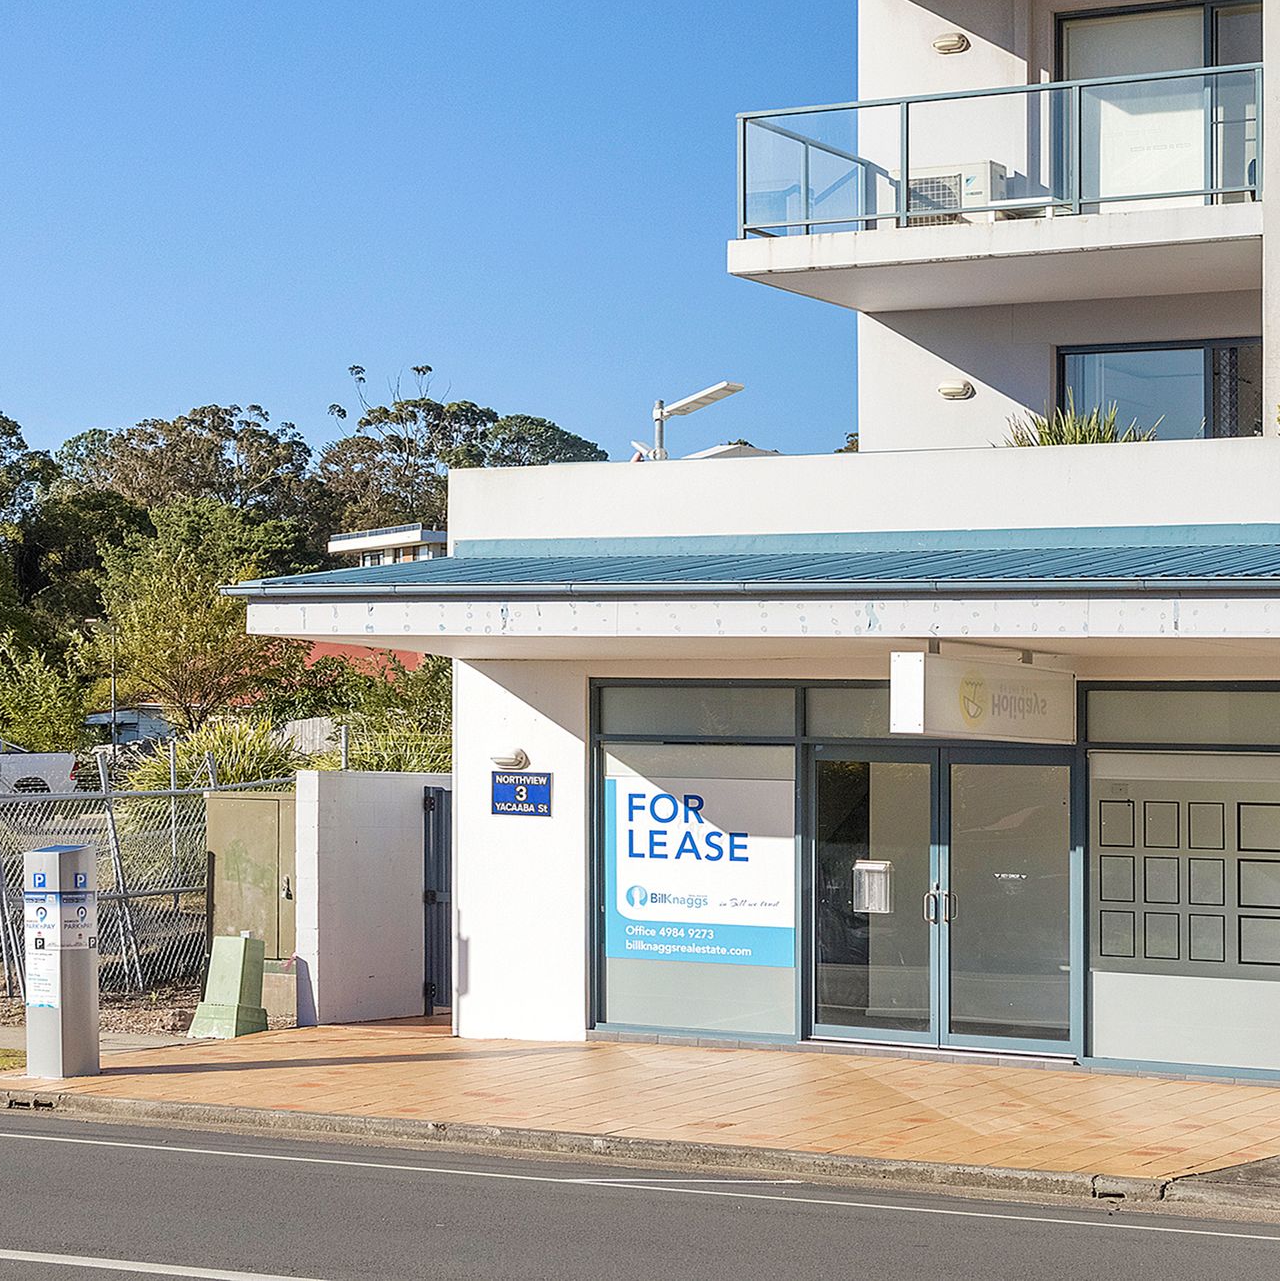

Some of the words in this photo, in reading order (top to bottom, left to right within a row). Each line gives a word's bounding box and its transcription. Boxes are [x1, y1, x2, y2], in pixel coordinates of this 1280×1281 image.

[496, 775, 547, 785] NORTHVIEW
[515, 785, 527, 802] 3
[495, 802, 535, 813] YACAABA
[537, 804, 548, 813] St
[628, 793, 705, 824] FOR
[628, 829, 749, 862] LEASE
[625, 925, 656, 936] Office
[659, 926, 685, 938] 4984
[688, 928, 715, 939] 9273
[625, 940, 752, 956] billknaggsrealestate.com
